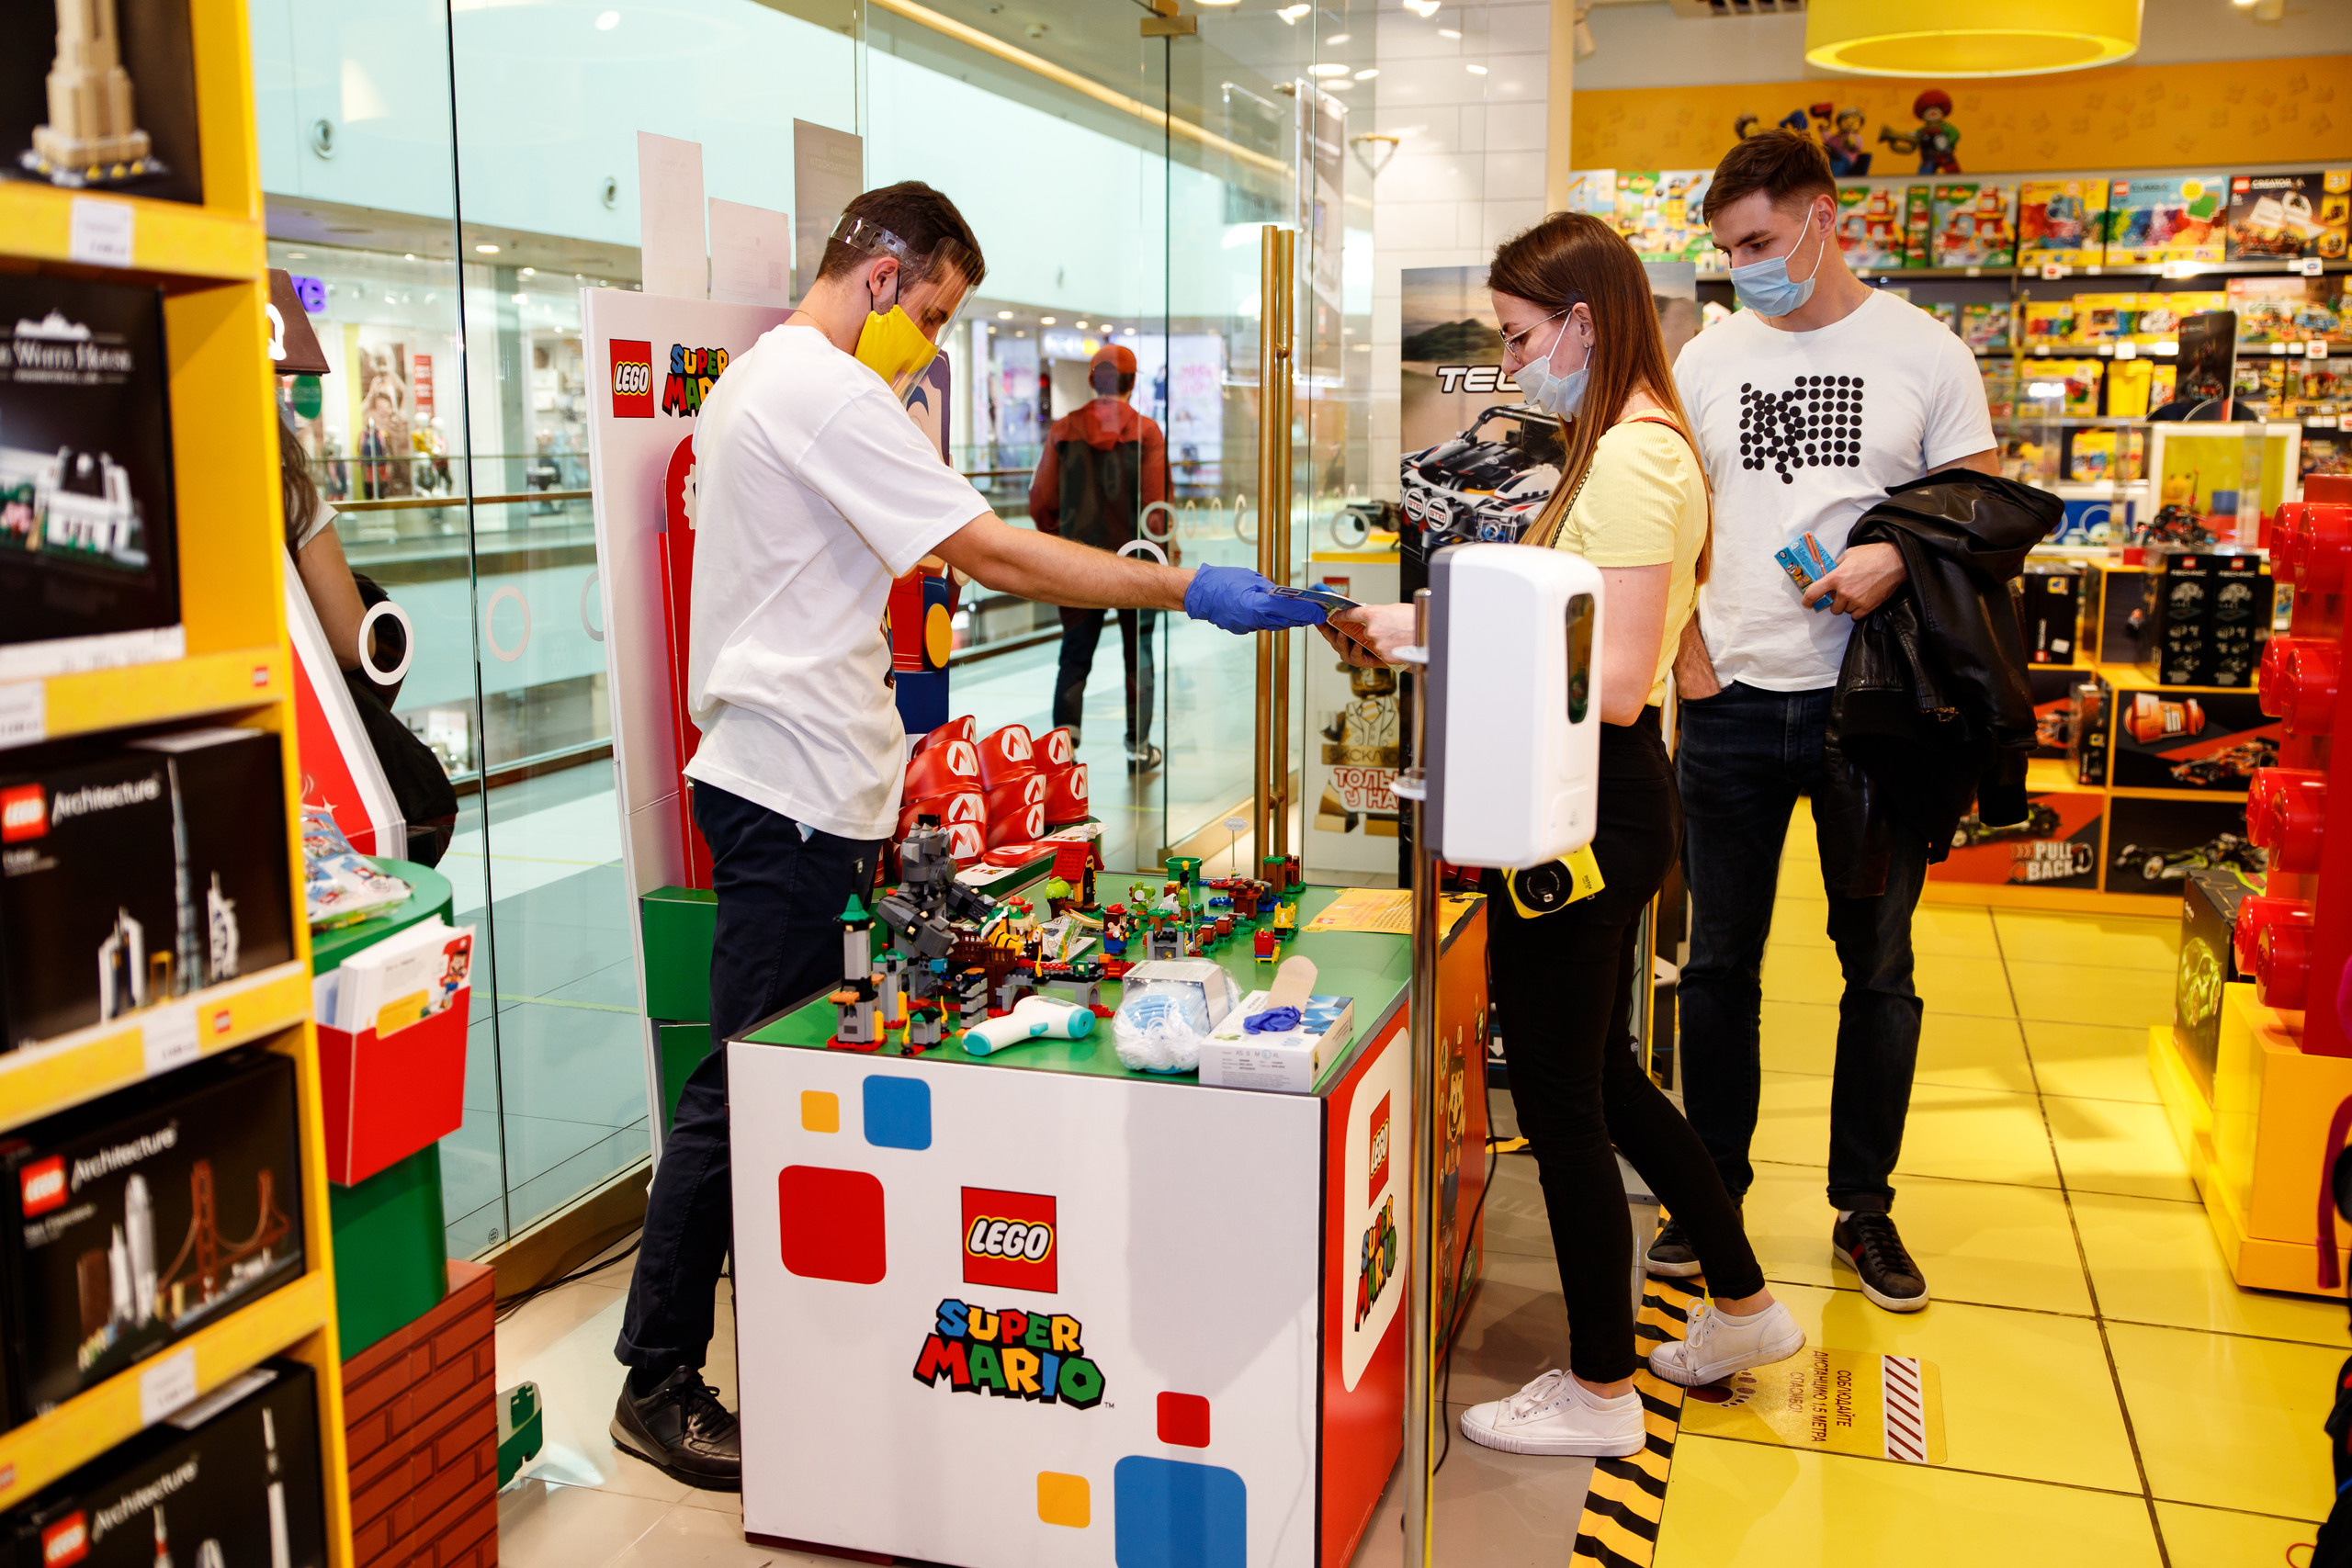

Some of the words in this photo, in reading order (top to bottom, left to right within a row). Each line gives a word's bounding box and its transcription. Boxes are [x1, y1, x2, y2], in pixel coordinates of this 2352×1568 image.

[615, 364, 650, 393] LEGO
[671, 344, 729, 376] SUPER
[662, 373, 718, 418] MAR
[51, 778, 159, 827] Architecture
[1345, 790, 1360, 807] У
[2026, 859, 2075, 882] BACK
[2033, 840, 2074, 860] PULL
[71, 1127, 177, 1194] Architecture
[1370, 1121, 1389, 1177] LEGO
[967, 1217, 1052, 1261] LEGO
[1361, 1194, 1394, 1273] SUPER
[1354, 1225, 1397, 1332] MARIO
[935, 1298, 1084, 1355] SUPER
[913, 1332, 1106, 1410] MARIO
[1811, 1350, 1828, 1401] ДИСТАНЦИЮ
[1812, 1402, 1828, 1414] 1,5
[1835, 1370, 1856, 1427] СОБЛЮДАЙТЕ
[1811, 1415, 1827, 1442] МЕТРА
[92, 1461, 198, 1544] Architecture
